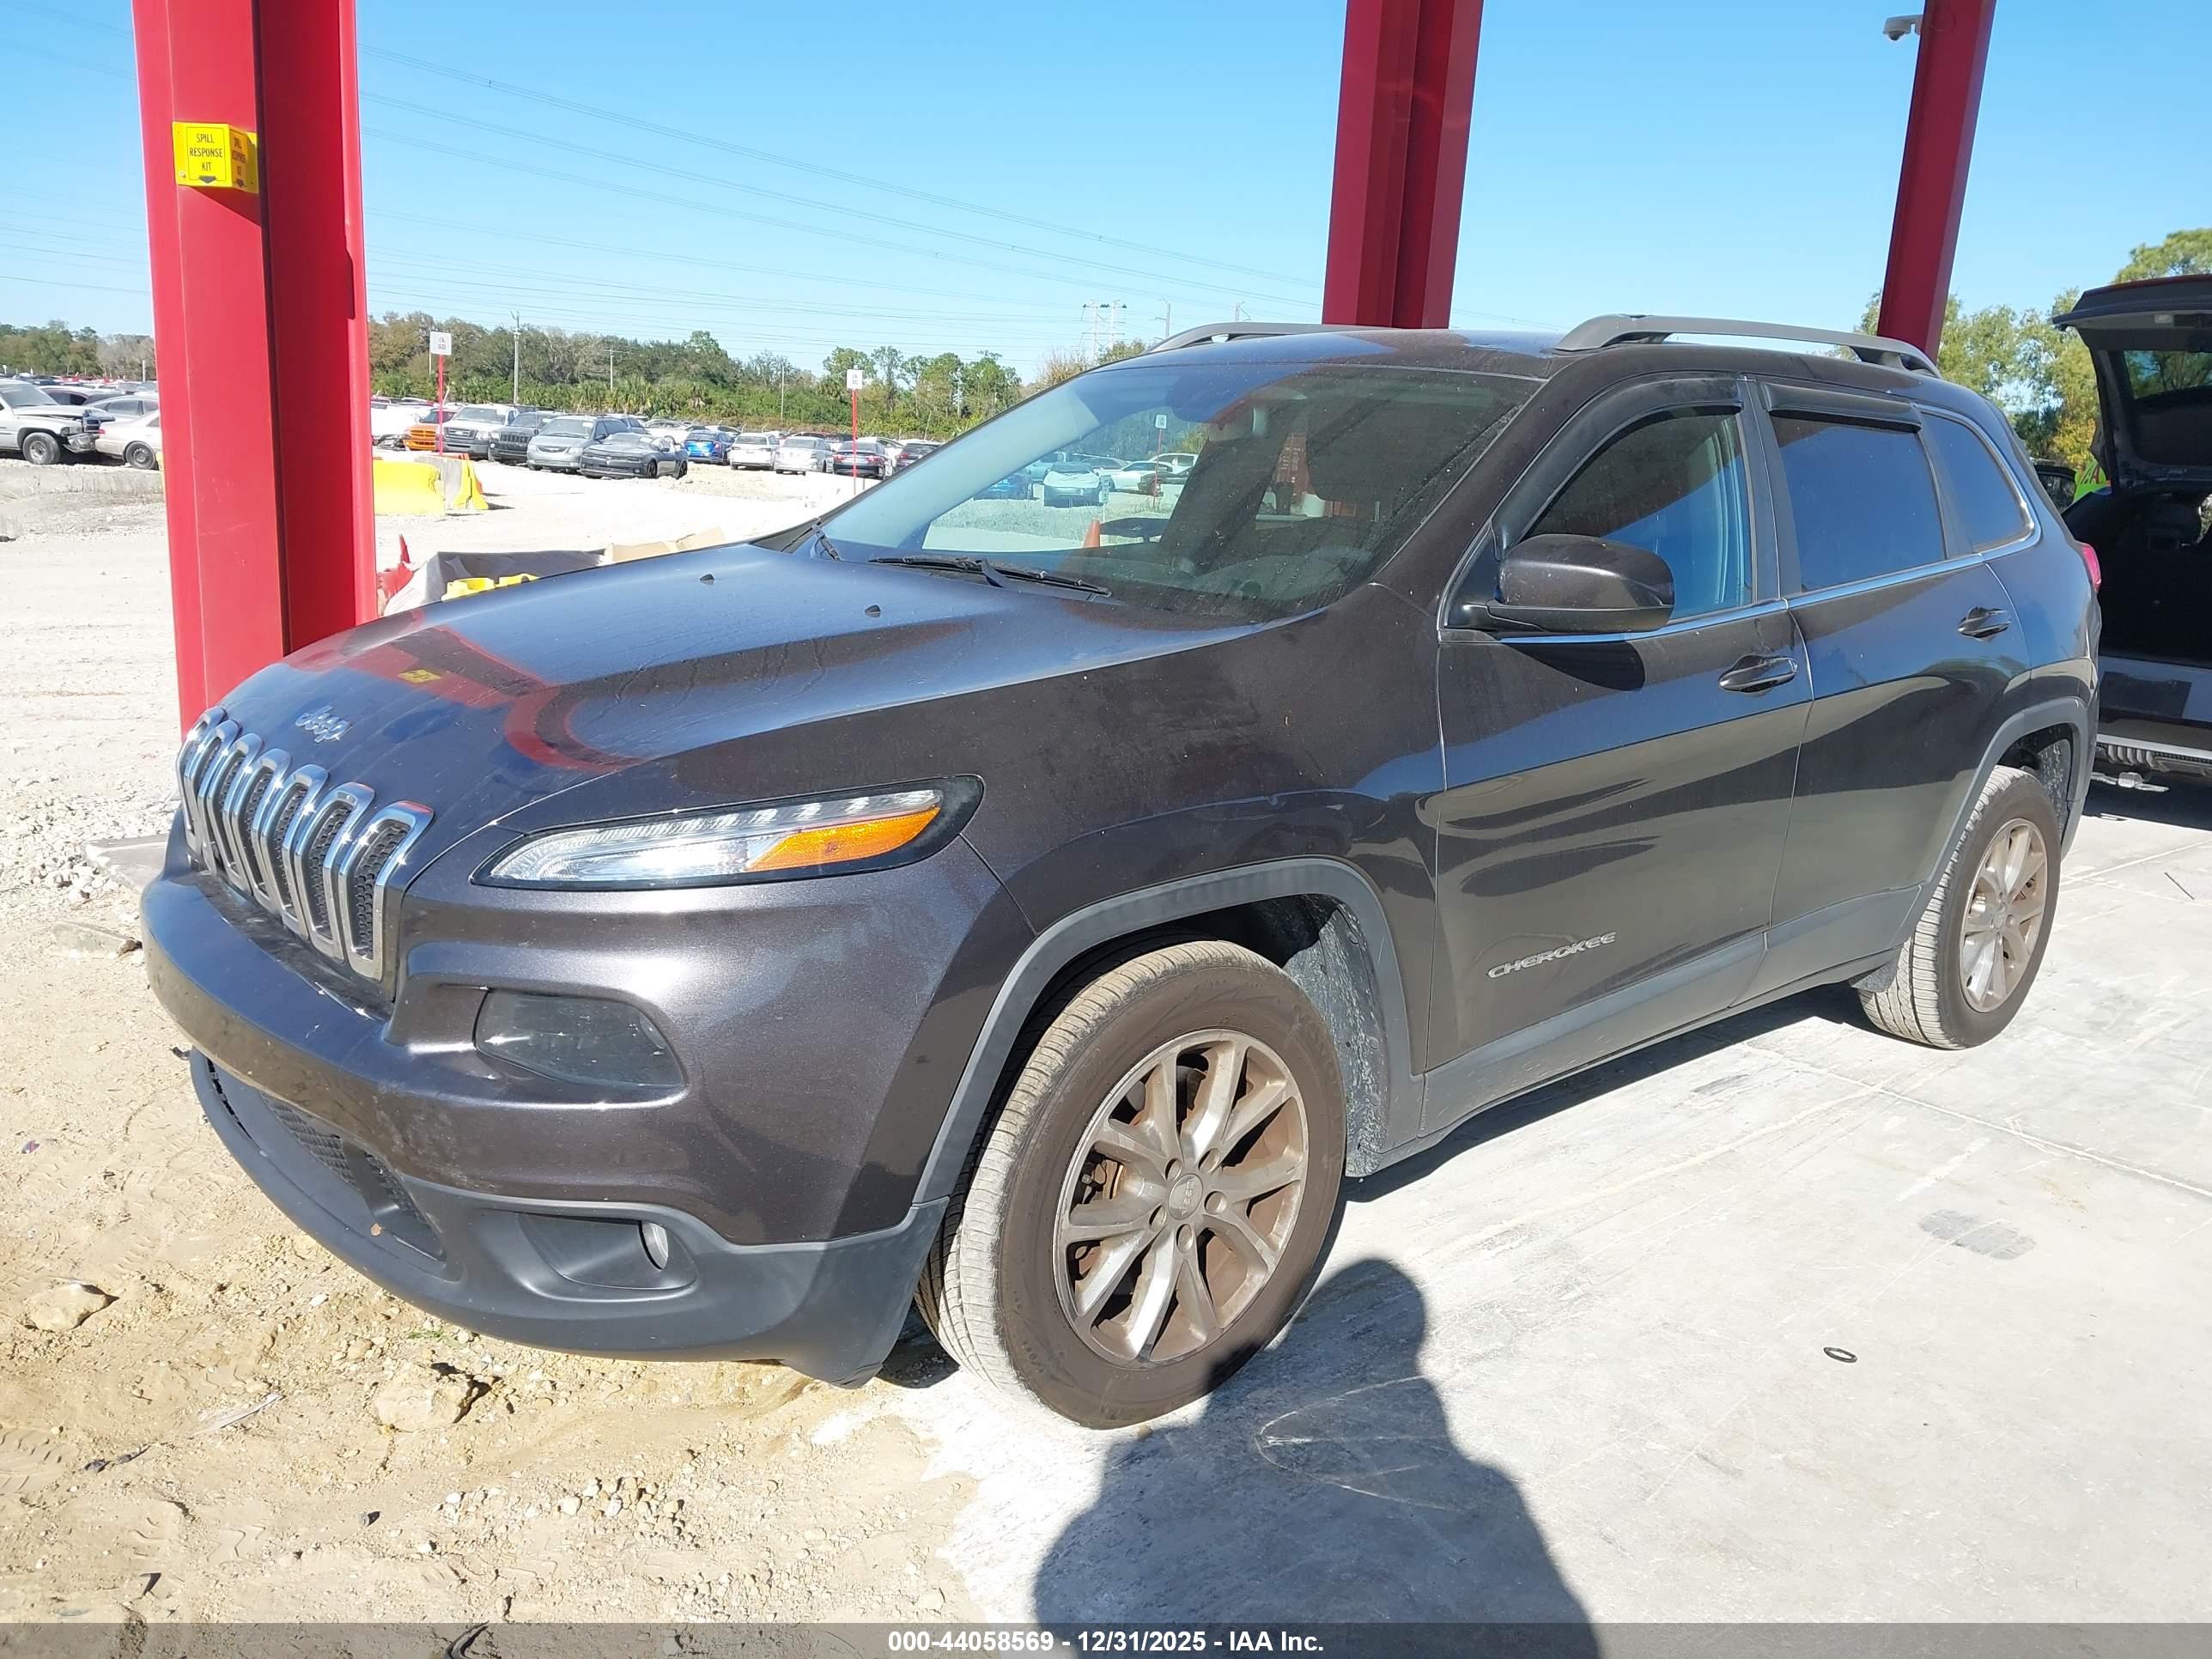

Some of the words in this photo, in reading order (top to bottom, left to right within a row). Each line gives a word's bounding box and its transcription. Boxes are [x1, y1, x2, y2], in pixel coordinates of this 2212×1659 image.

[196, 133, 215, 143] SPILL
[189, 147, 223, 158] RESPONSE
[201, 161, 212, 172] KIT
[1488, 932, 1616, 978] CHEROKEE
